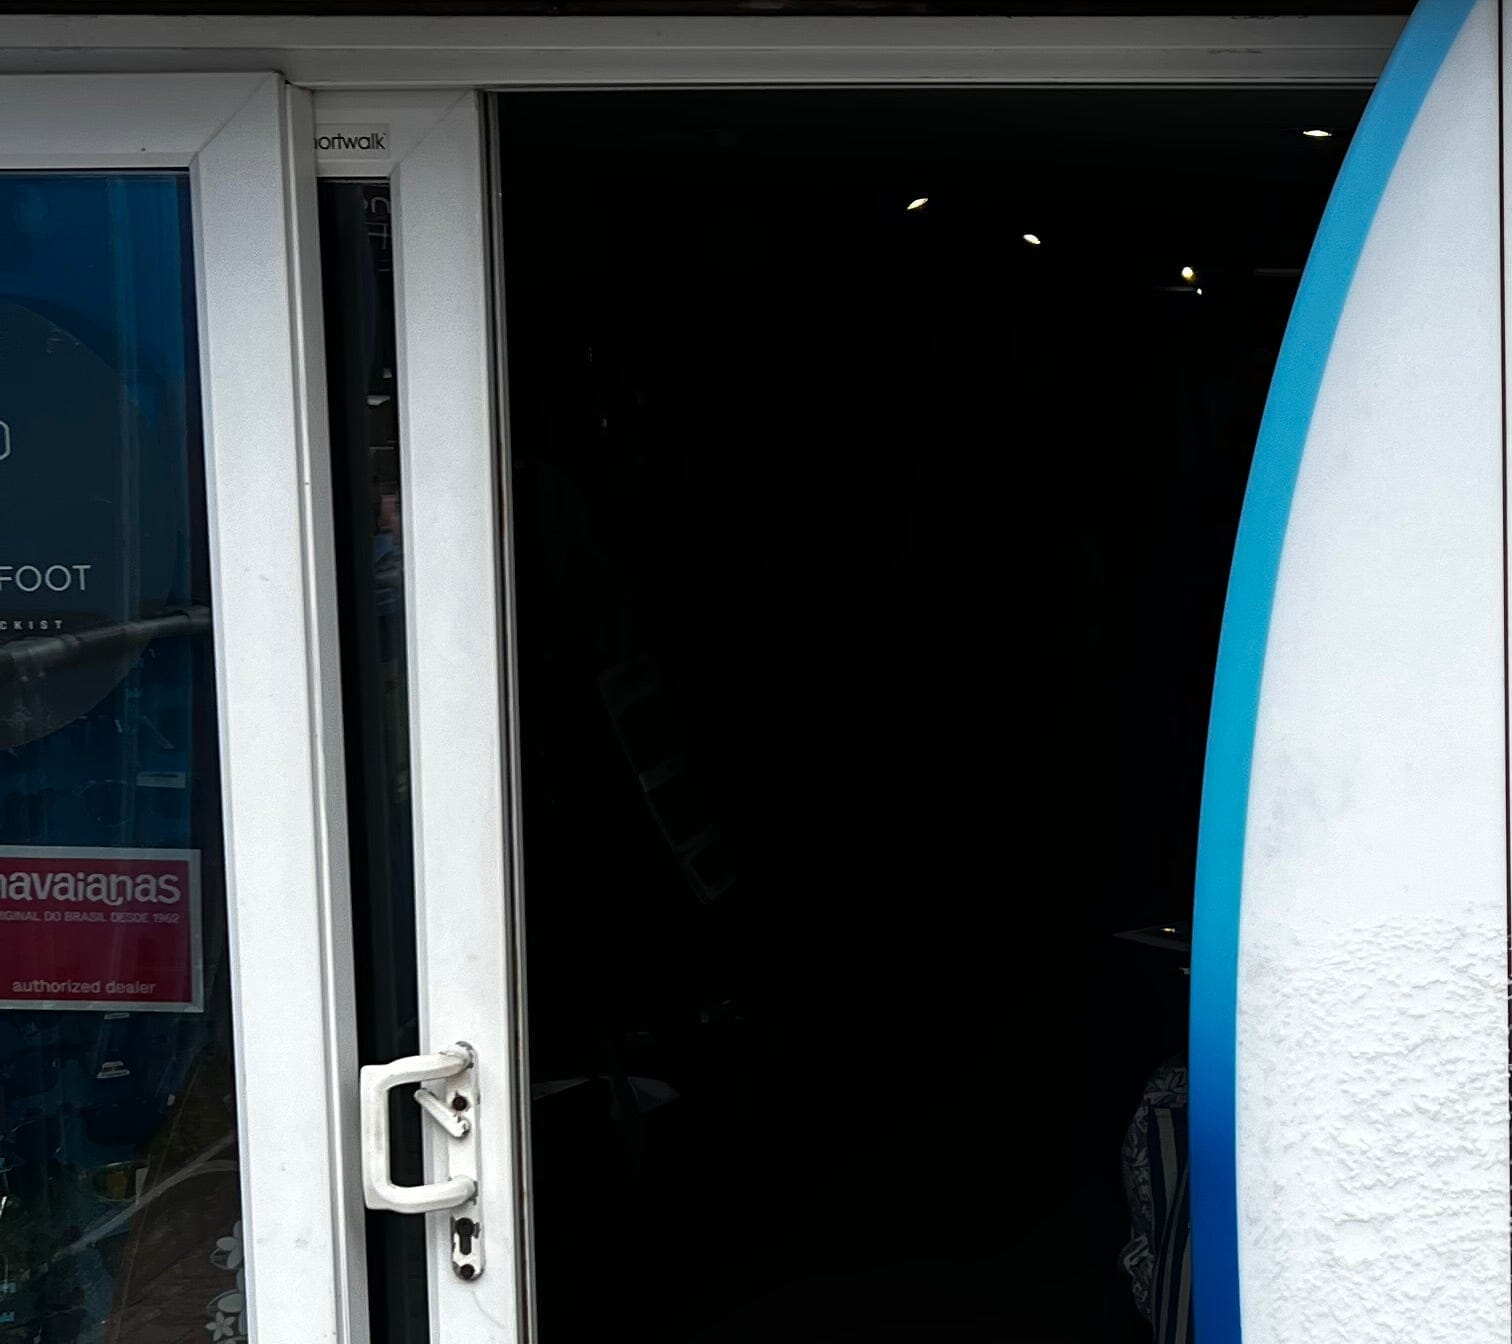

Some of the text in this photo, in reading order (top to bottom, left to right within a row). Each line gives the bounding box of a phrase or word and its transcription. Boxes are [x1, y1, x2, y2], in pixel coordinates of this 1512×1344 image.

[0, 565, 92, 592] FOOT
[64, 911, 106, 923] BRASIL
[12, 979, 156, 994] authorized dealer
